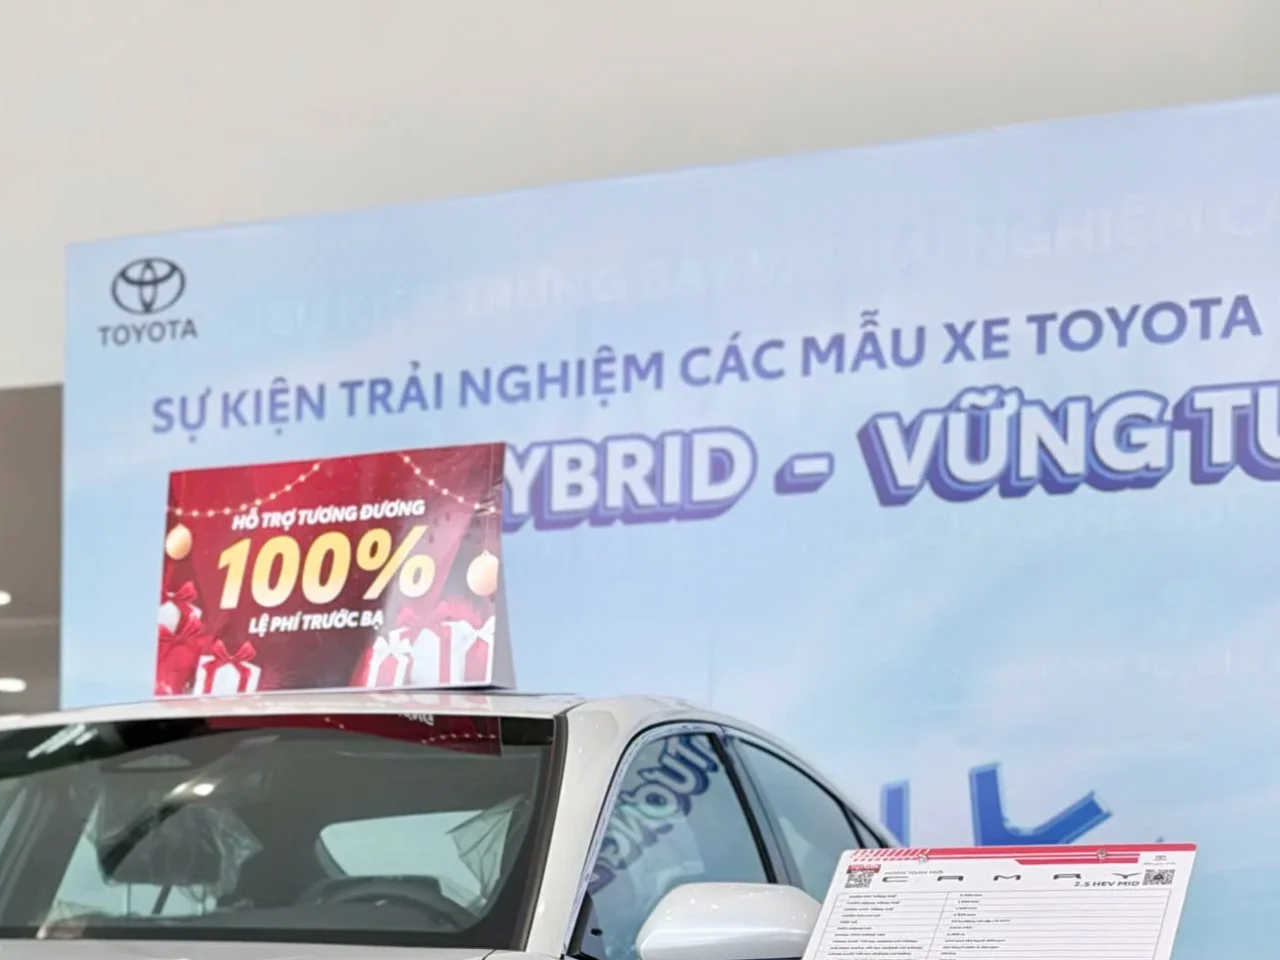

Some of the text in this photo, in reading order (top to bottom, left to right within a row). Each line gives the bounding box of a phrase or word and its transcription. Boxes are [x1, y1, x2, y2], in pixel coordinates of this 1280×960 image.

[98, 318, 198, 347] TOYOTA
[152, 294, 1263, 443] SỰ KIỆN TRẢI NGHIỆM CÁC MẪU XE TOYOTA
[501, 424, 759, 533] YBRID
[856, 383, 1174, 508] VỮNG
[231, 499, 426, 532] HỖ TRỢ TƯƠNG ĐƯƠNG
[217, 524, 436, 610] 100%
[248, 608, 384, 638] LỆ PHÍ TRƯỚC BẠ
[882, 872, 1143, 883] CAMRY
